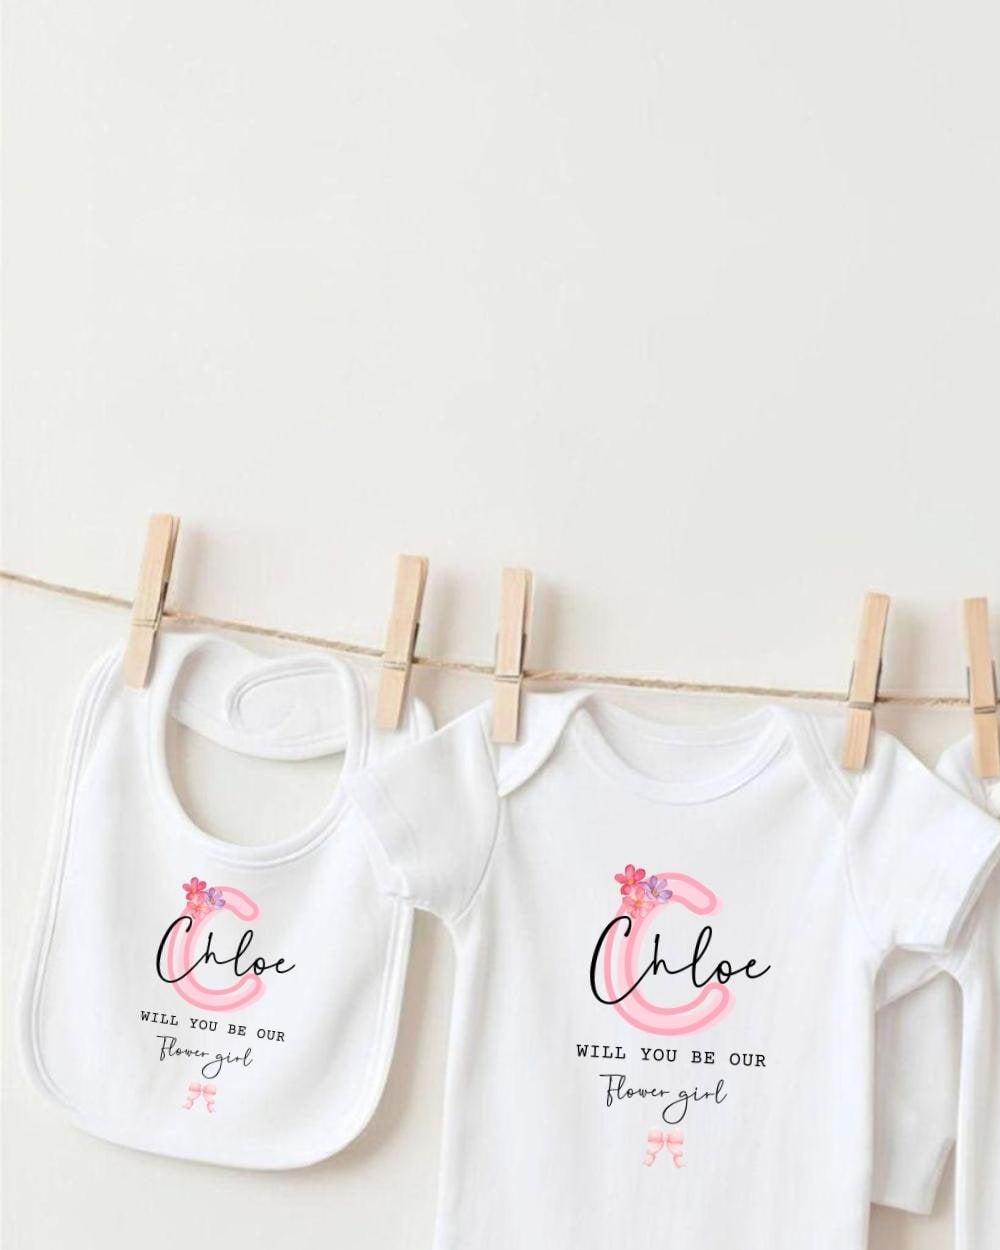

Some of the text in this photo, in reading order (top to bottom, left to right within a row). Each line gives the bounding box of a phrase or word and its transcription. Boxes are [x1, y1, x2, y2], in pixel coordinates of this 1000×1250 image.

[156, 916, 295, 983] Chloe
[590, 916, 771, 1005] Chloe
[140, 1010, 285, 1042] WILL YOU BE OUR
[157, 1035, 252, 1079] Flower girl
[576, 1044, 766, 1067] WILL YOU BE OUR
[600, 1074, 727, 1124] Flower girl
